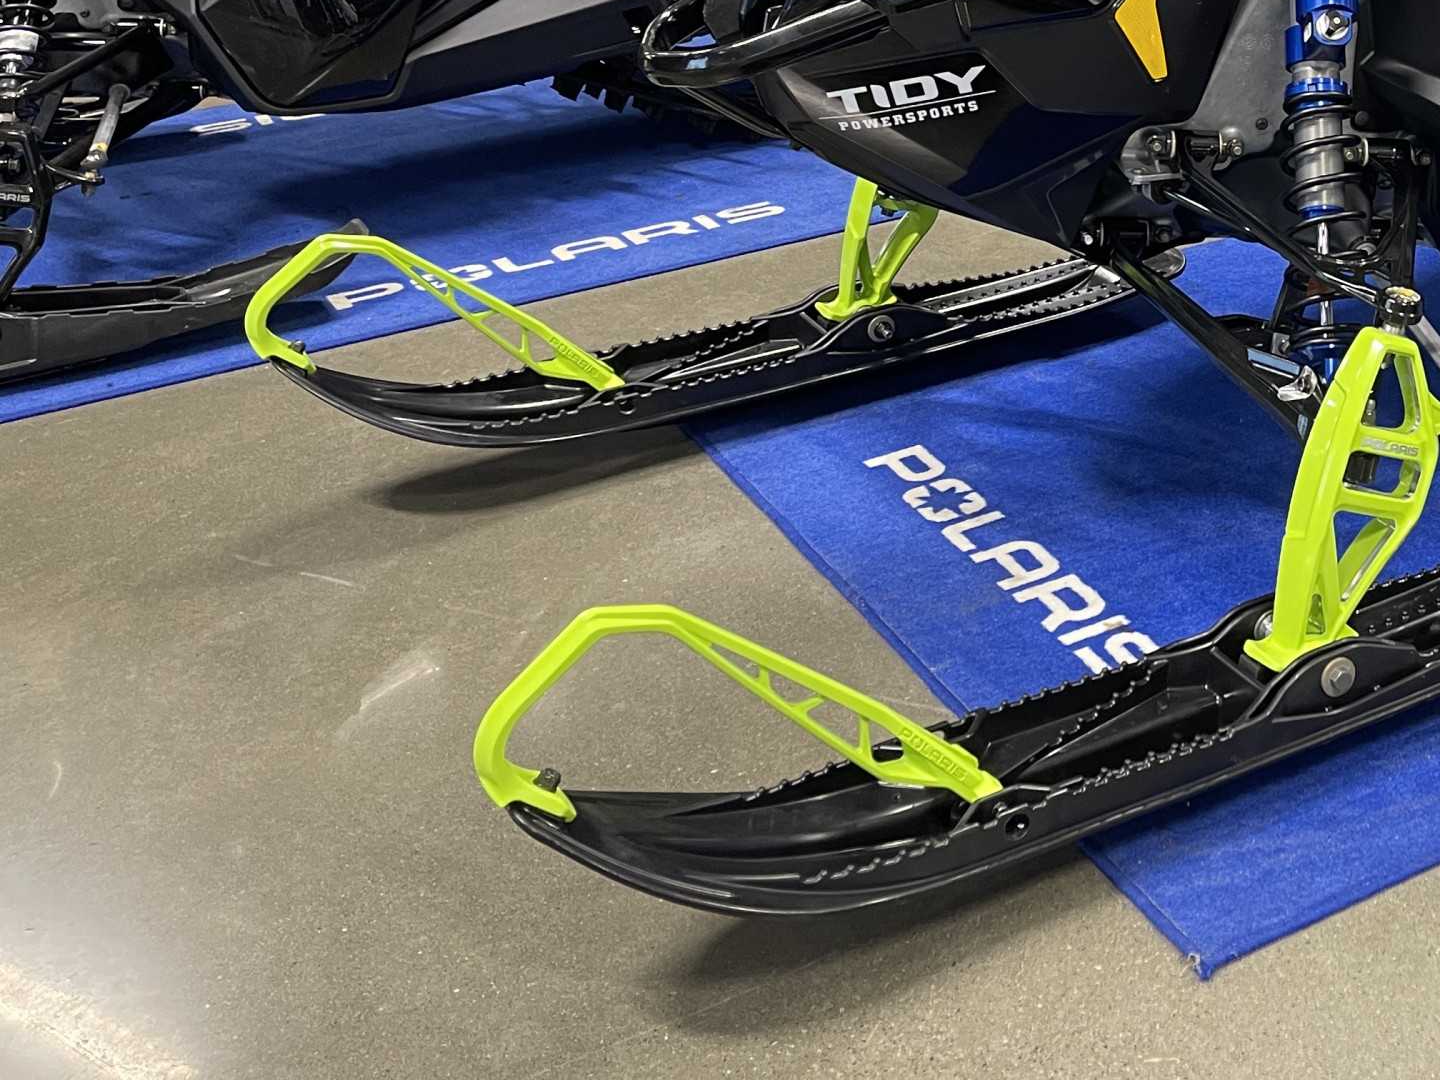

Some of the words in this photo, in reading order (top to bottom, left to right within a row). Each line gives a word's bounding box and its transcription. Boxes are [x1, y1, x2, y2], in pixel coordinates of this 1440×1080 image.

[825, 64, 986, 114] TIDY
[838, 100, 979, 131] POWERSPORTS
[862, 444, 1160, 675] POLARIS
[899, 726, 968, 782] POLARIS
